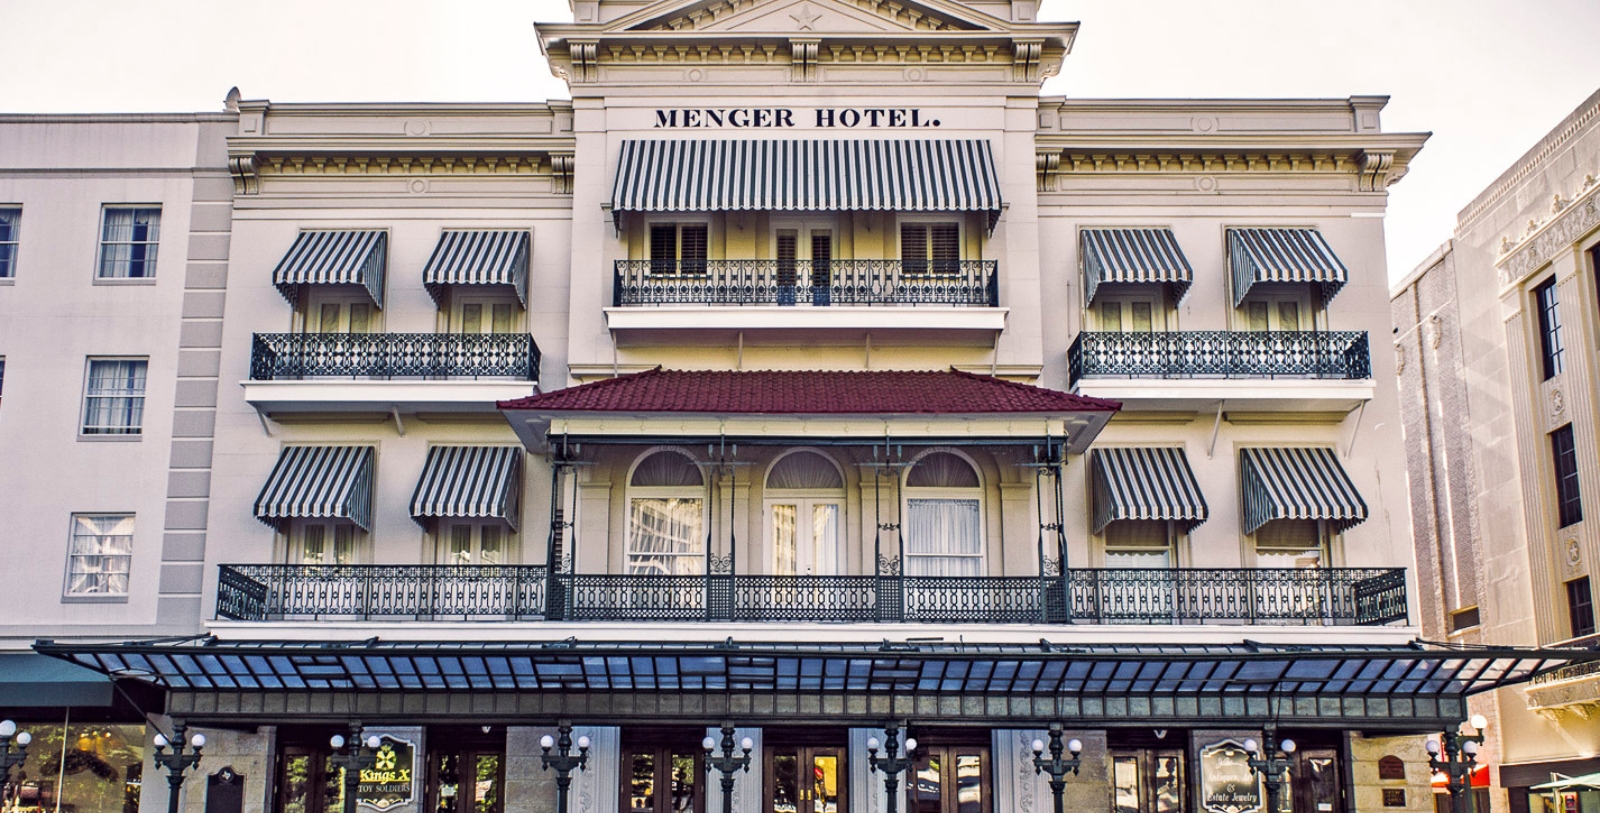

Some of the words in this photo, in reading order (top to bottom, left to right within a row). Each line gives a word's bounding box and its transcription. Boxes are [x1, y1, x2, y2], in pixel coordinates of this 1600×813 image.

[654, 108, 795, 128] MENGER
[815, 108, 941, 128] HOTEL.
[360, 769, 395, 784] Kings
[399, 769, 410, 781] X
[1207, 792, 1229, 801] Estate
[1232, 792, 1257, 802] Jewelry
